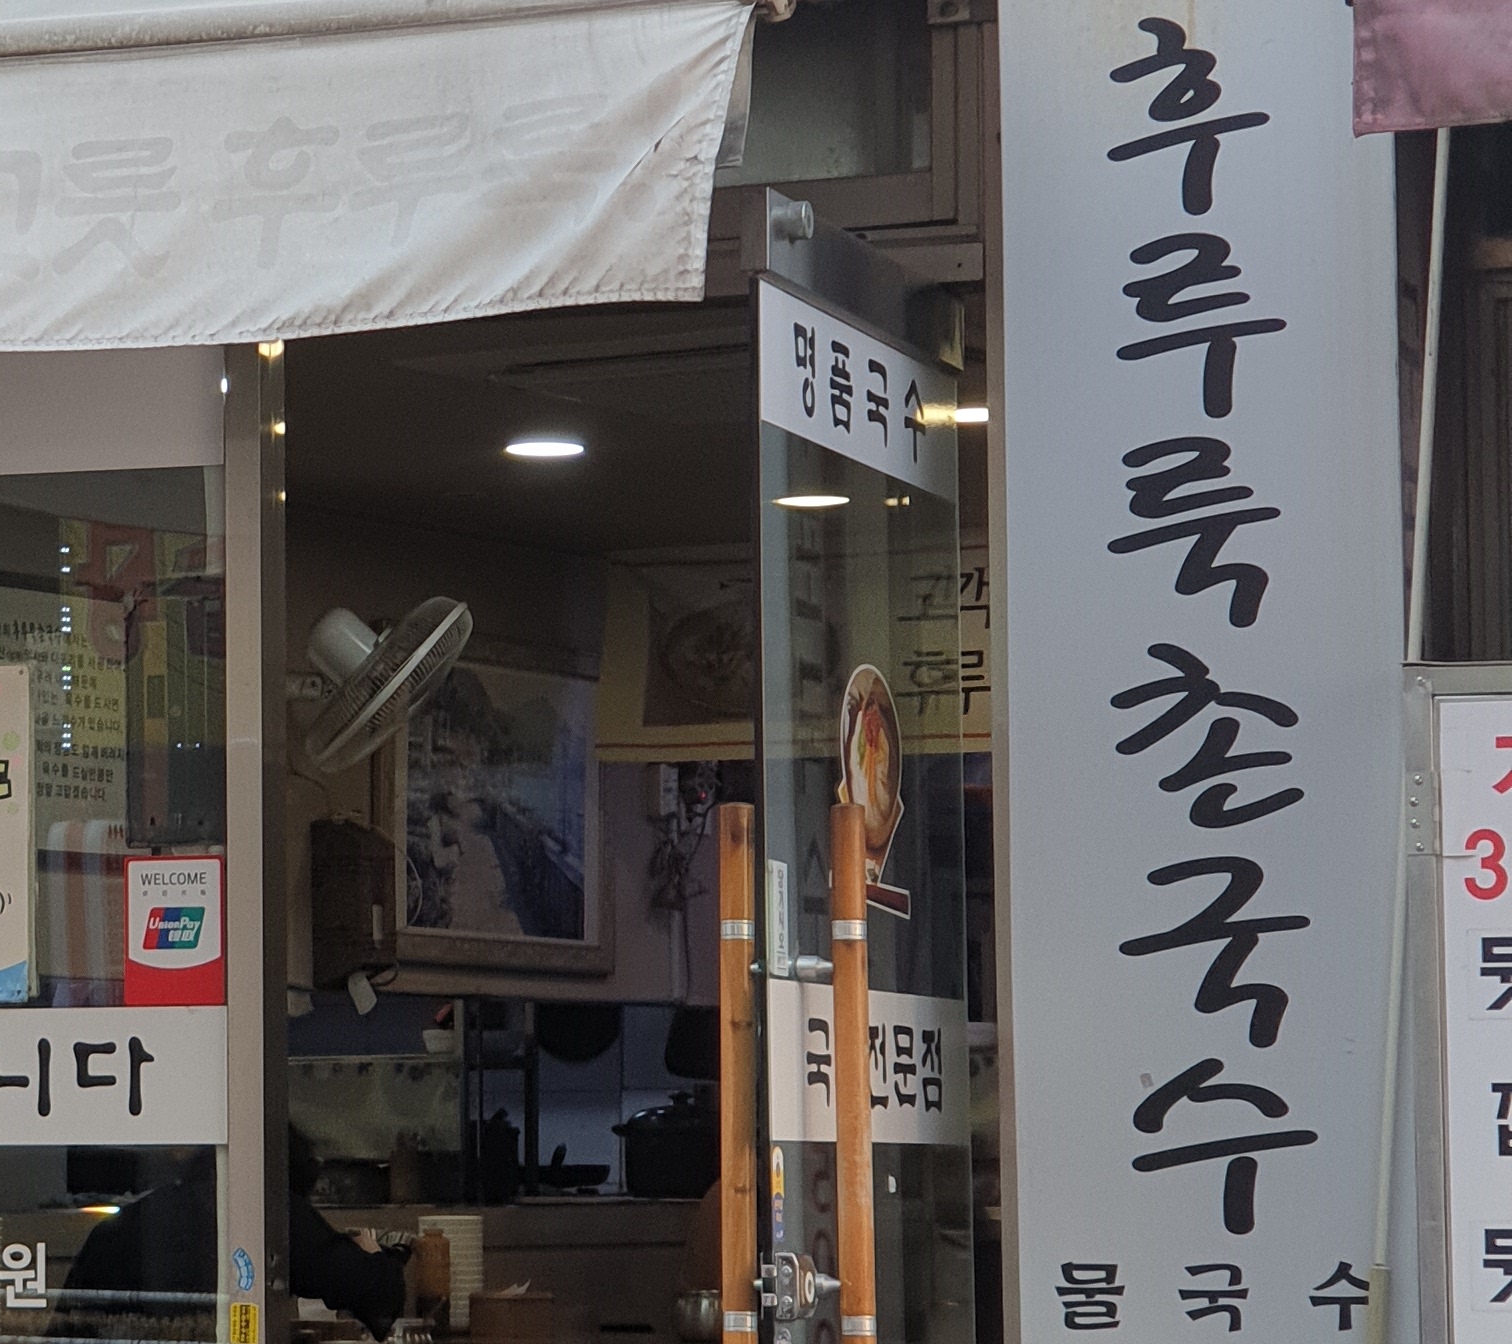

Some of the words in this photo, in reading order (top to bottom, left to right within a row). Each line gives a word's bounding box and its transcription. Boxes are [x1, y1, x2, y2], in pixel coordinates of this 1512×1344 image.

[794, 322, 926, 463] 명품국수
[1107, 17, 1318, 1234] 후루룩촌국수
[140, 871, 207, 886] WELCOME
[149, 916, 201, 933] UnionPay
